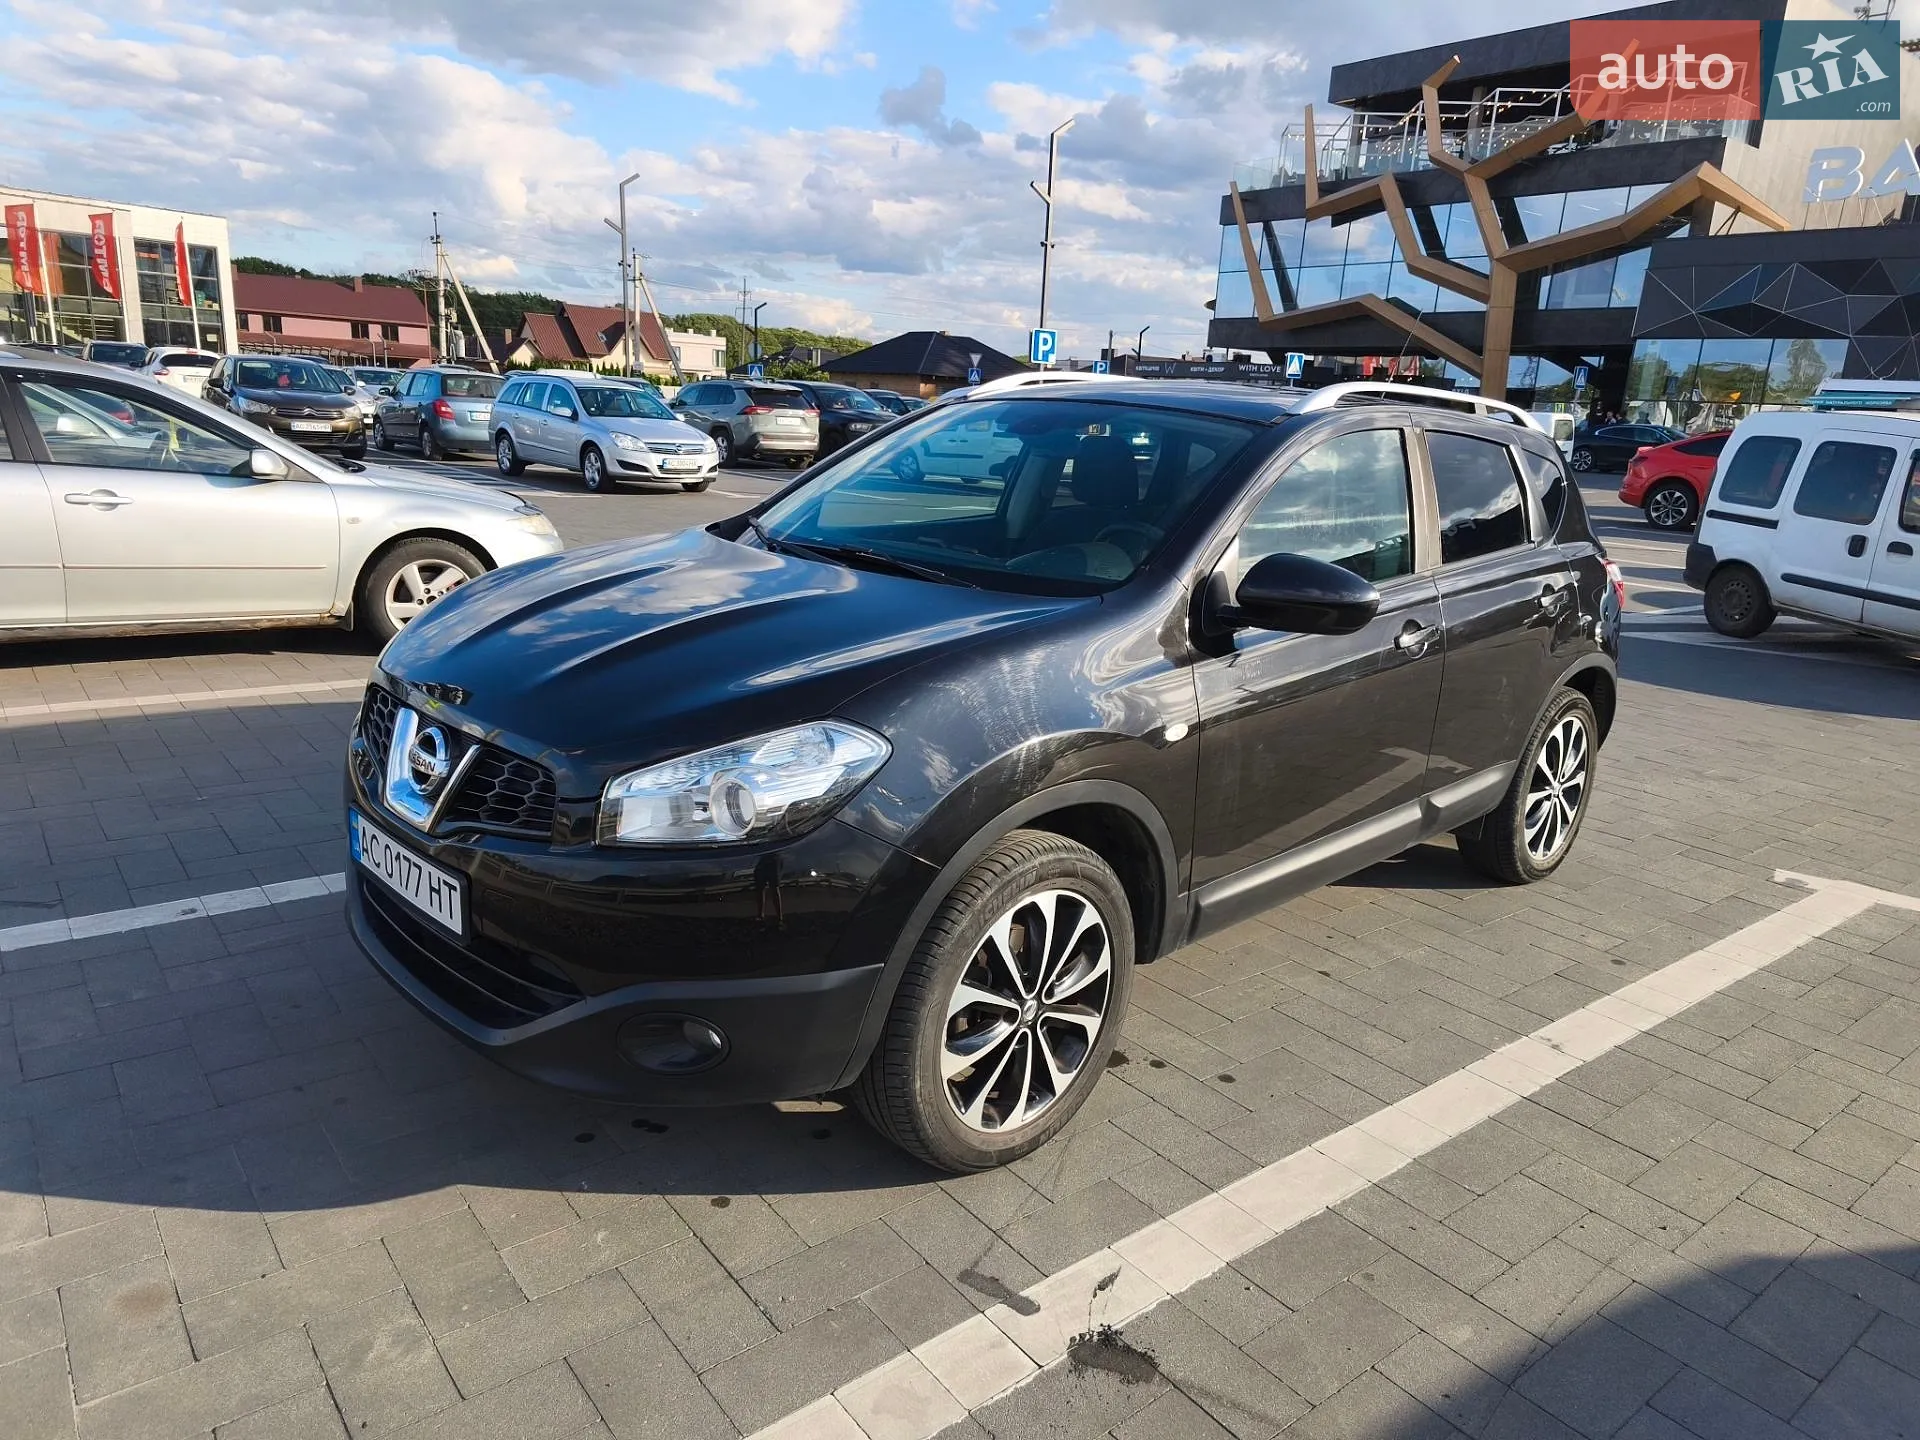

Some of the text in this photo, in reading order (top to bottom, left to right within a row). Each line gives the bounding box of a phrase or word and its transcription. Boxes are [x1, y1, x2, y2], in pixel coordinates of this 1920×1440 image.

[1038, 332, 1053, 360] P
[1096, 362, 1106, 374] P
[1238, 364, 1281, 373] WITH LOVE
[361, 826, 458, 920] AC 0177 HT
